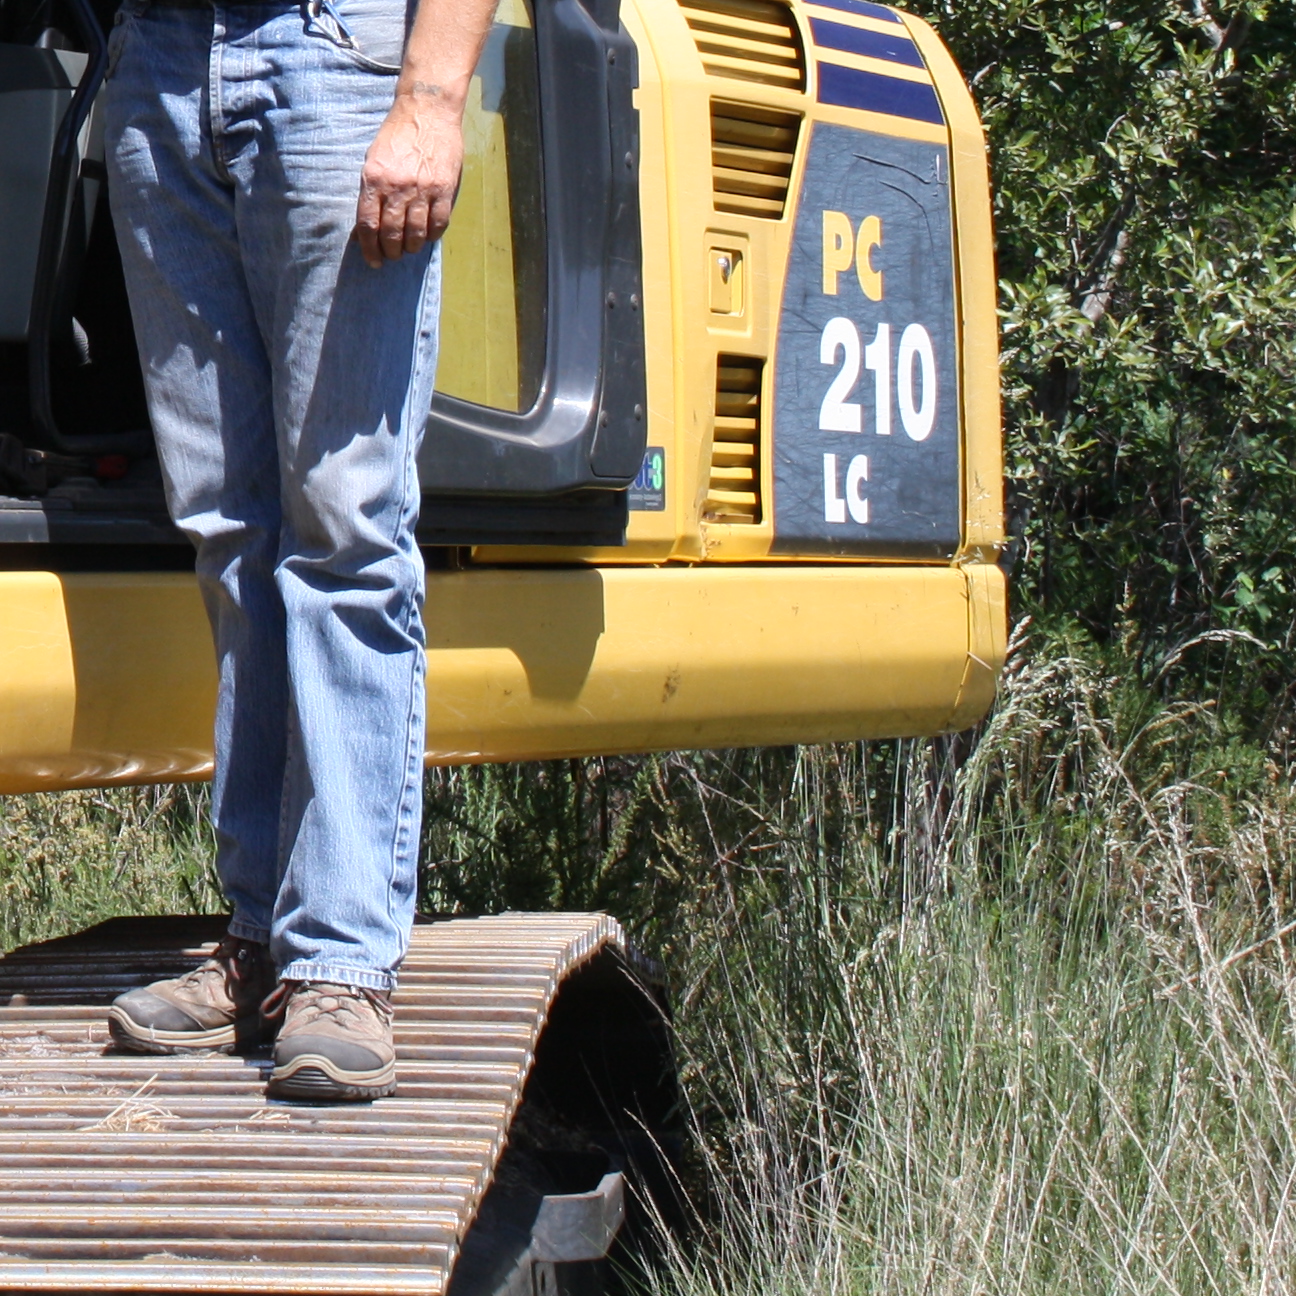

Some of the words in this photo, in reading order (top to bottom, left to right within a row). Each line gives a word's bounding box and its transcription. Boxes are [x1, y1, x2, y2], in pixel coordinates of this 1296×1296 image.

[822, 209, 883, 302] PC
[818, 316, 937, 442] 210
[823, 452, 869, 524] LC
